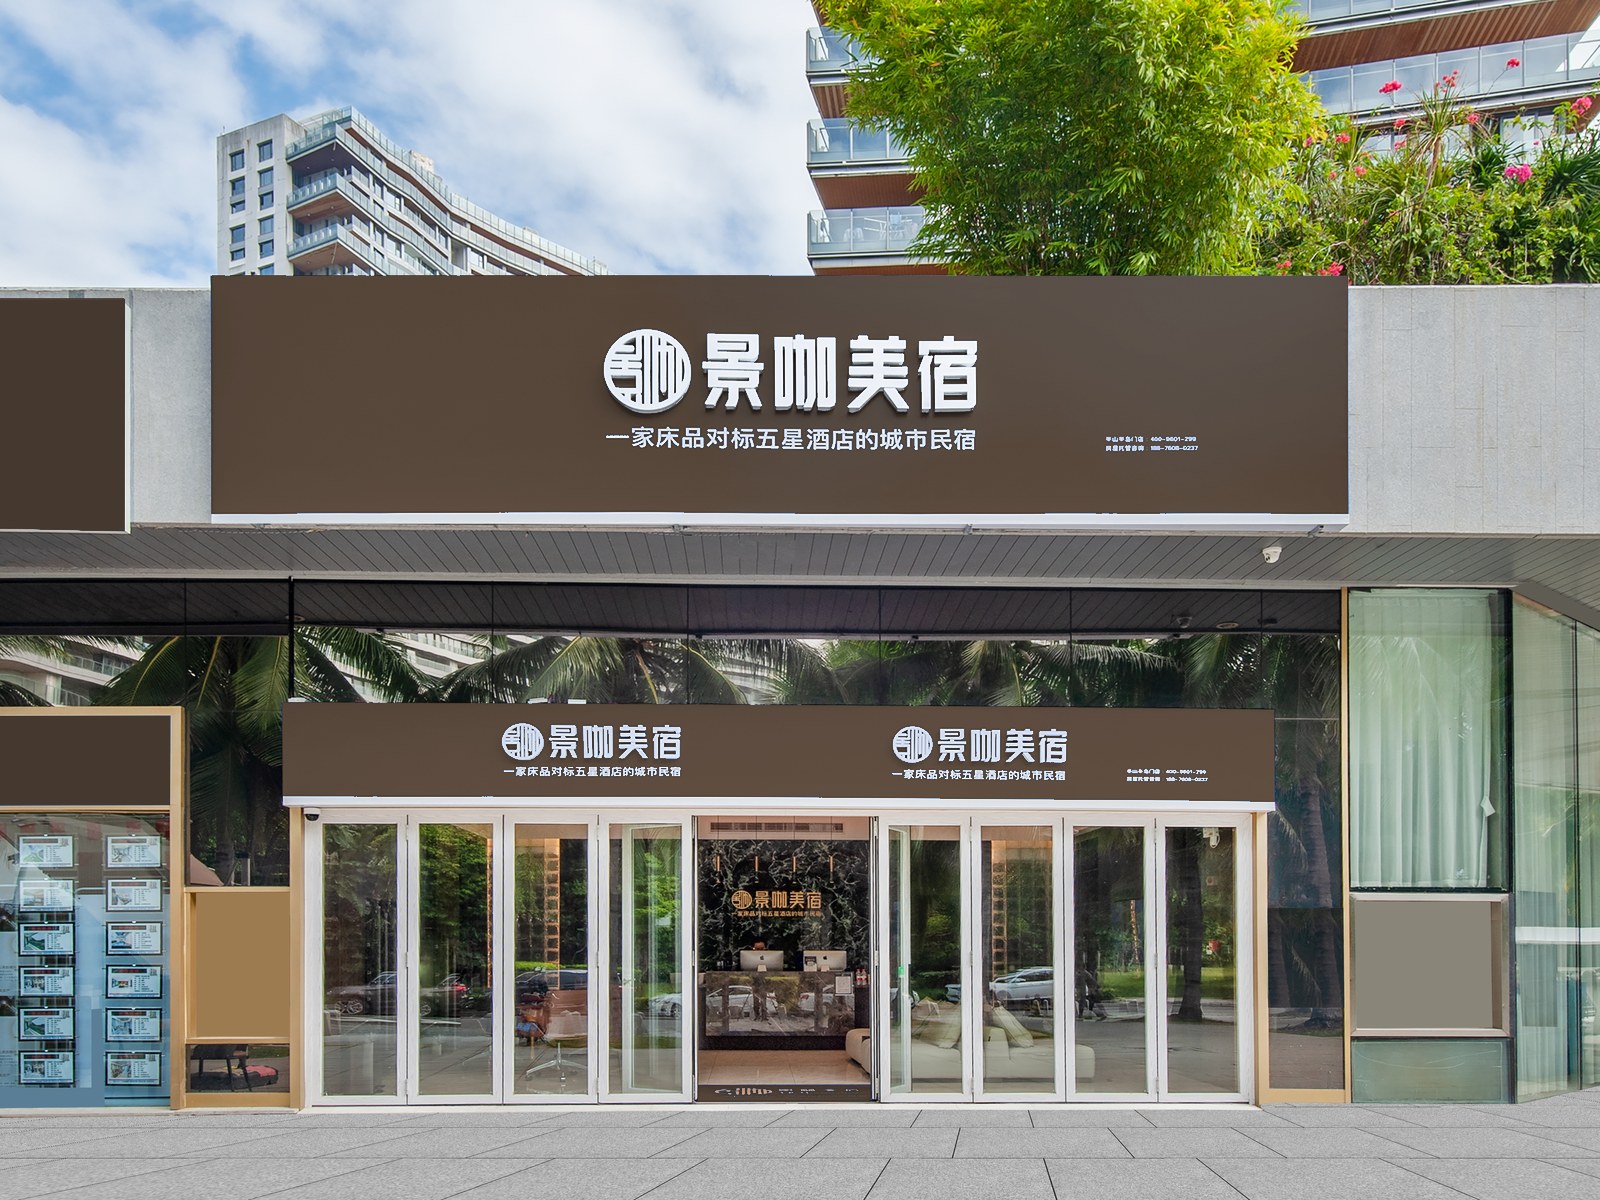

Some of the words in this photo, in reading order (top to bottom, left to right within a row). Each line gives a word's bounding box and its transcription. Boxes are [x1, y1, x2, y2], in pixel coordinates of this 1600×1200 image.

[702, 333, 979, 414] 景咖美宿
[606, 426, 976, 451] 一家床品对标五星酒店的城市民宿
[549, 724, 682, 760] 景咖美宿
[938, 728, 1068, 764] 景咖美宿
[503, 766, 681, 777] 一家床品对标五星酒店的城市民宿
[891, 768, 1066, 781] 一家床品对标五星酒店的城市民宿
[755, 890, 822, 909] 景咖美宿
